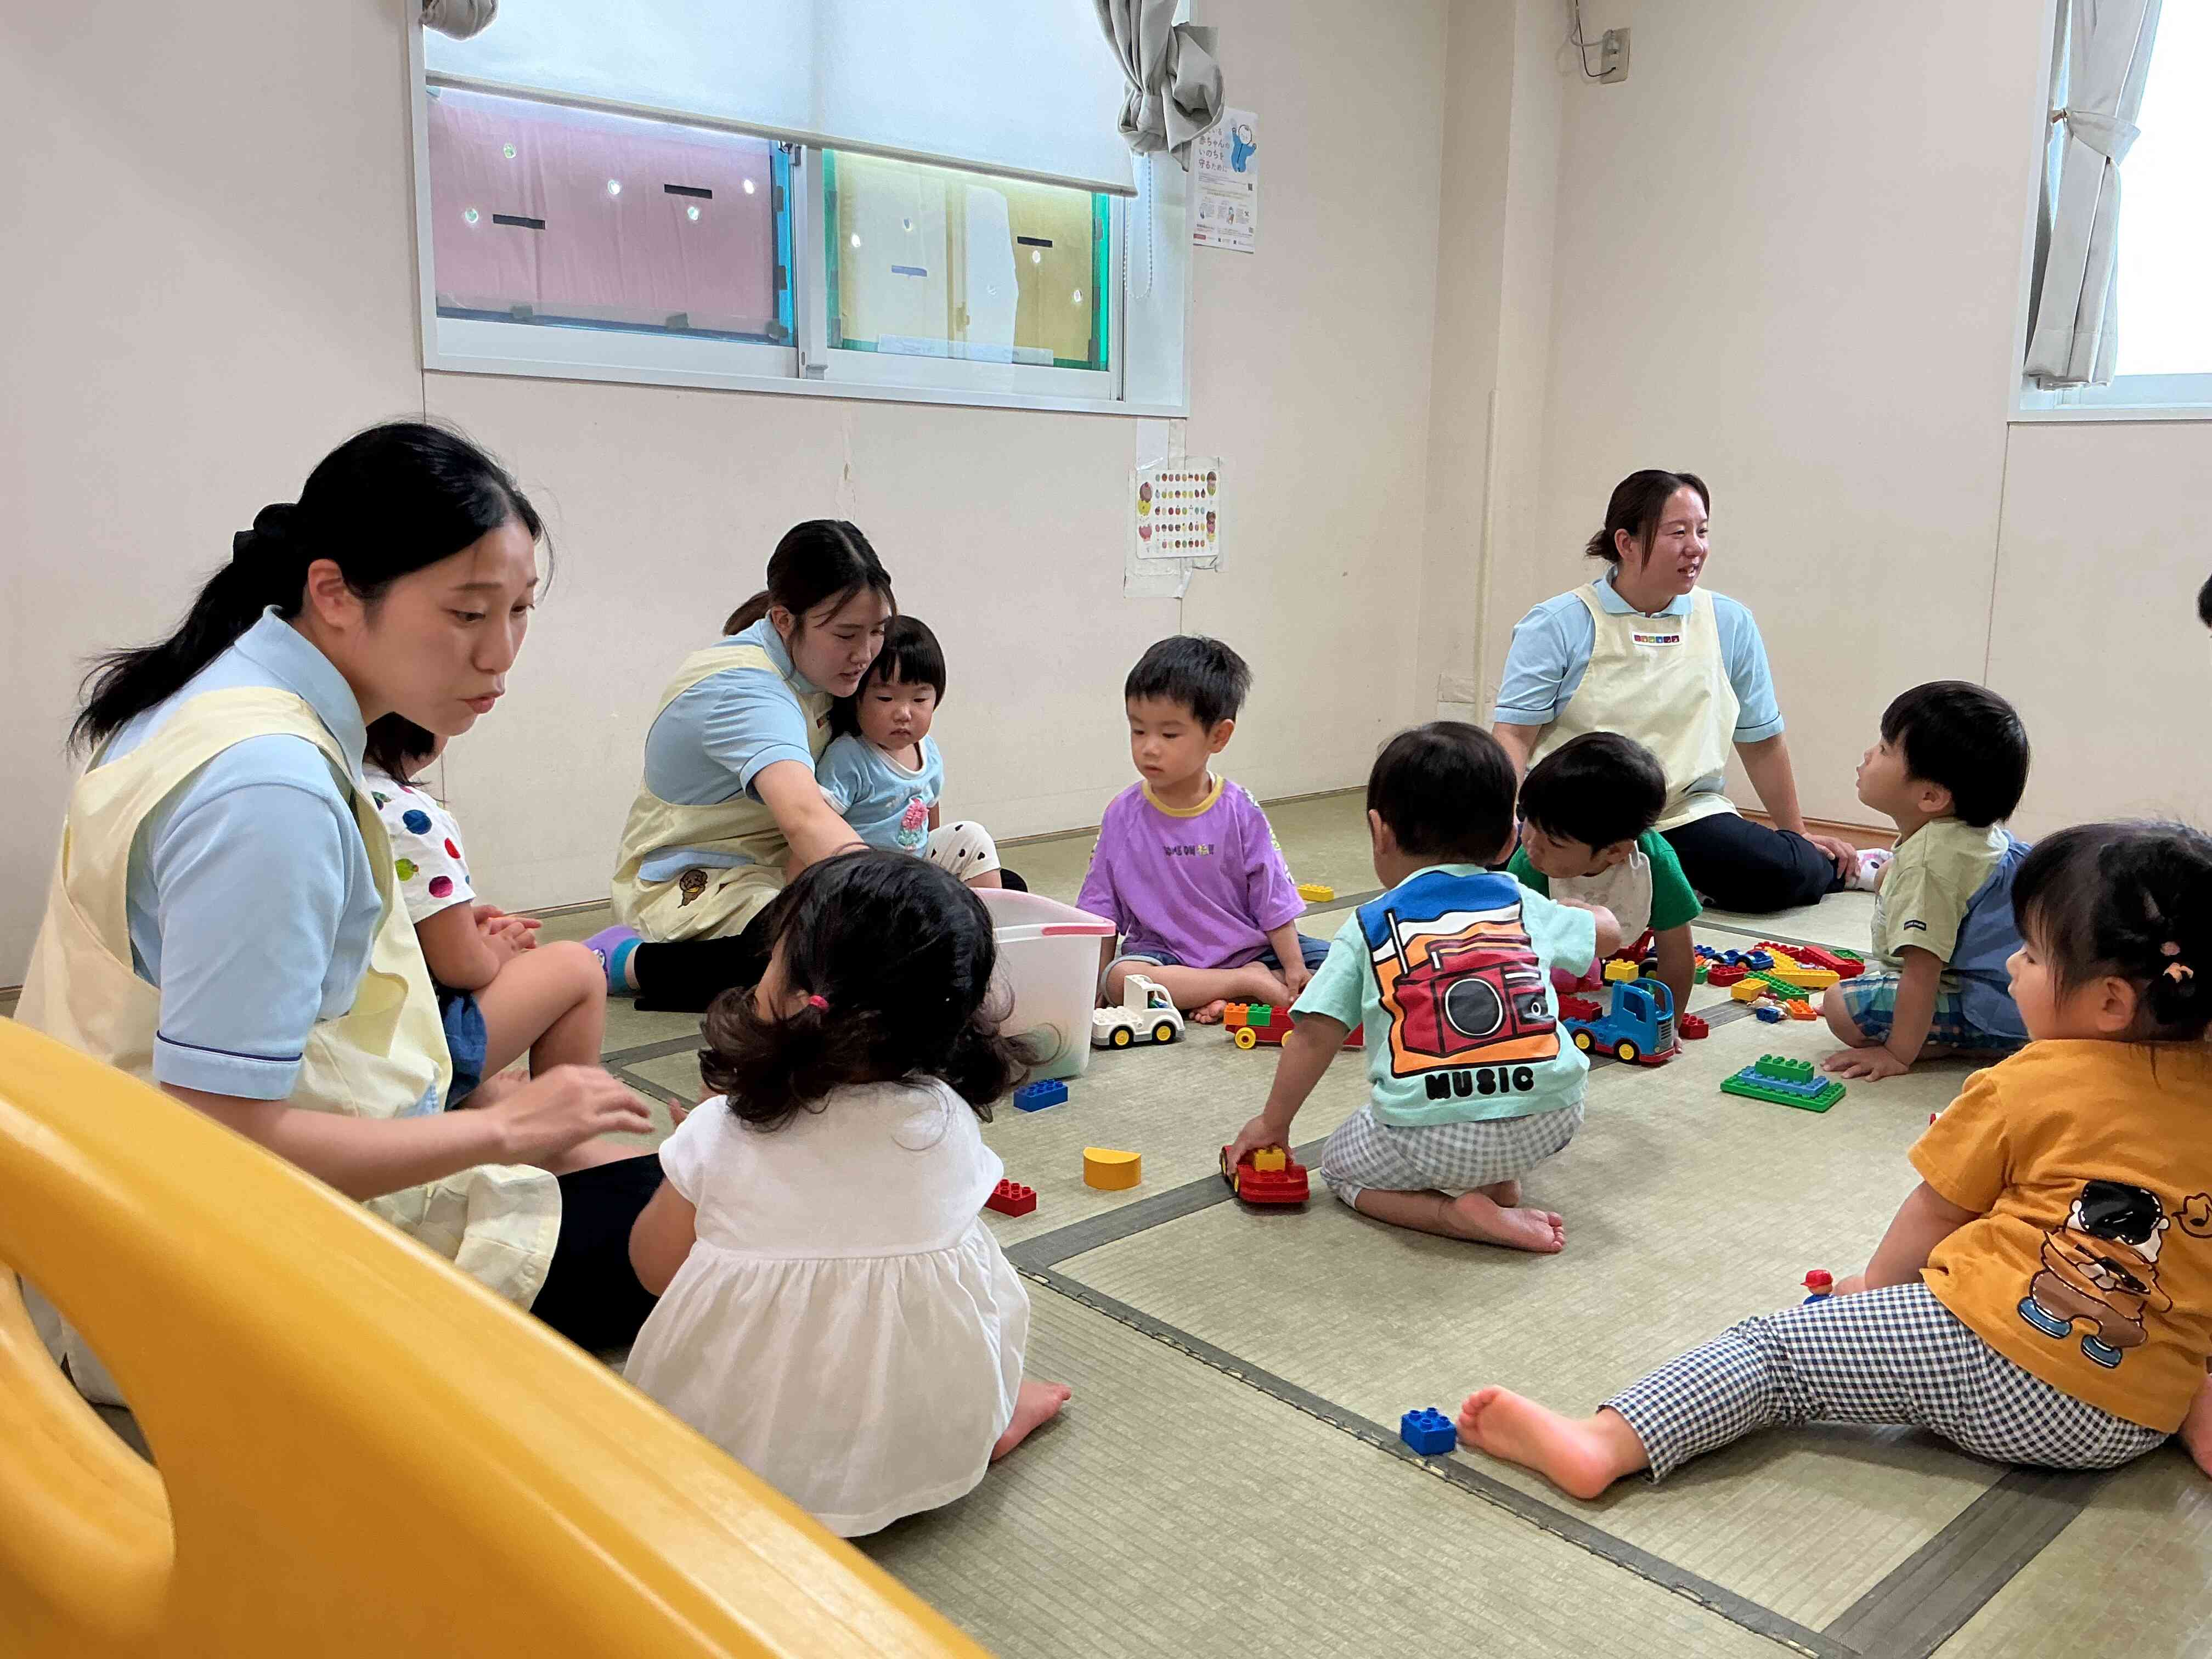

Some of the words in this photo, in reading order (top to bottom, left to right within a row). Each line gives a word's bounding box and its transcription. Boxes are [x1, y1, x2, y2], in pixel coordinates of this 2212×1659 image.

[1199, 149, 1224, 160] いのちを
[1198, 159, 1228, 173] 守るために
[1425, 1066, 1534, 1101] MUSIC
